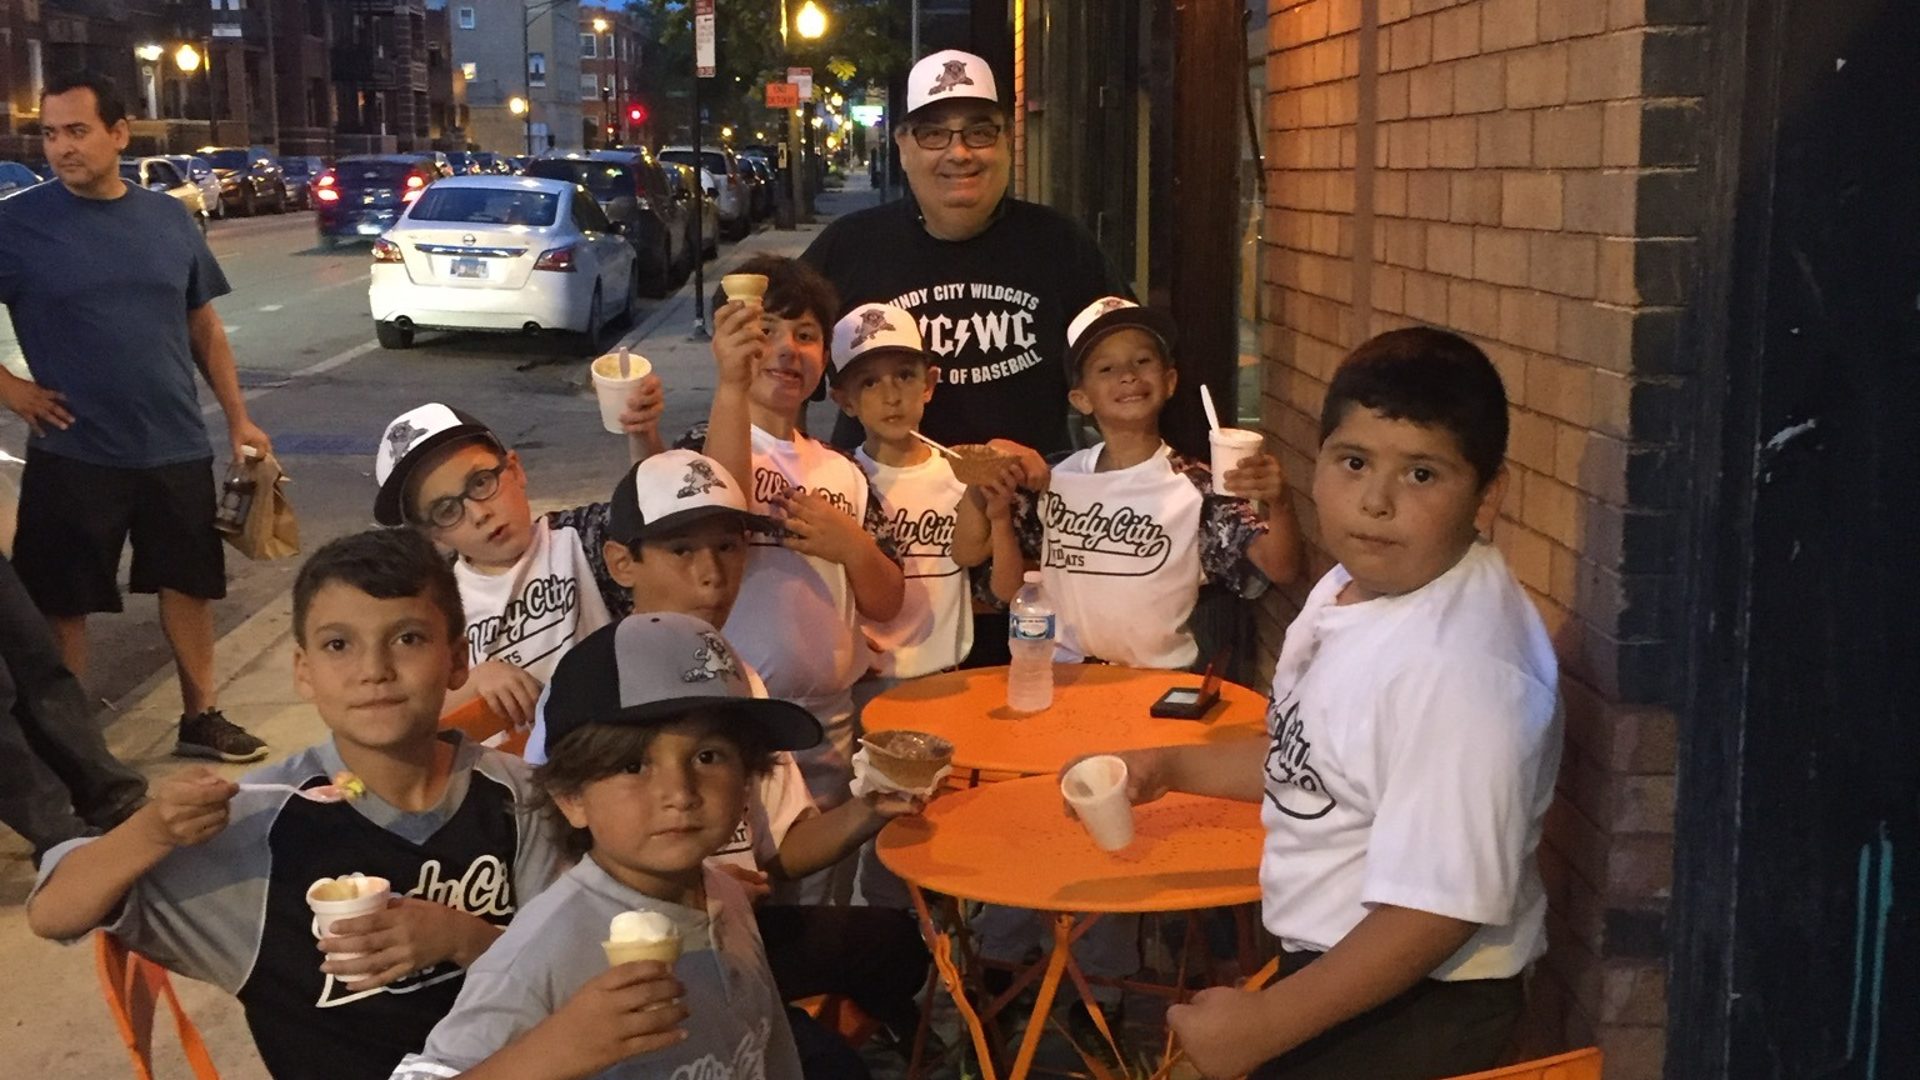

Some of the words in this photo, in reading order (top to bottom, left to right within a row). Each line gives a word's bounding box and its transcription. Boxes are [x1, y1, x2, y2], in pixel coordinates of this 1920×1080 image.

[933, 283, 966, 302] CITY
[970, 283, 1040, 311] WILDCATS
[949, 368, 969, 385] OF
[971, 349, 1042, 385] BASEBALL
[1109, 506, 1163, 557] City
